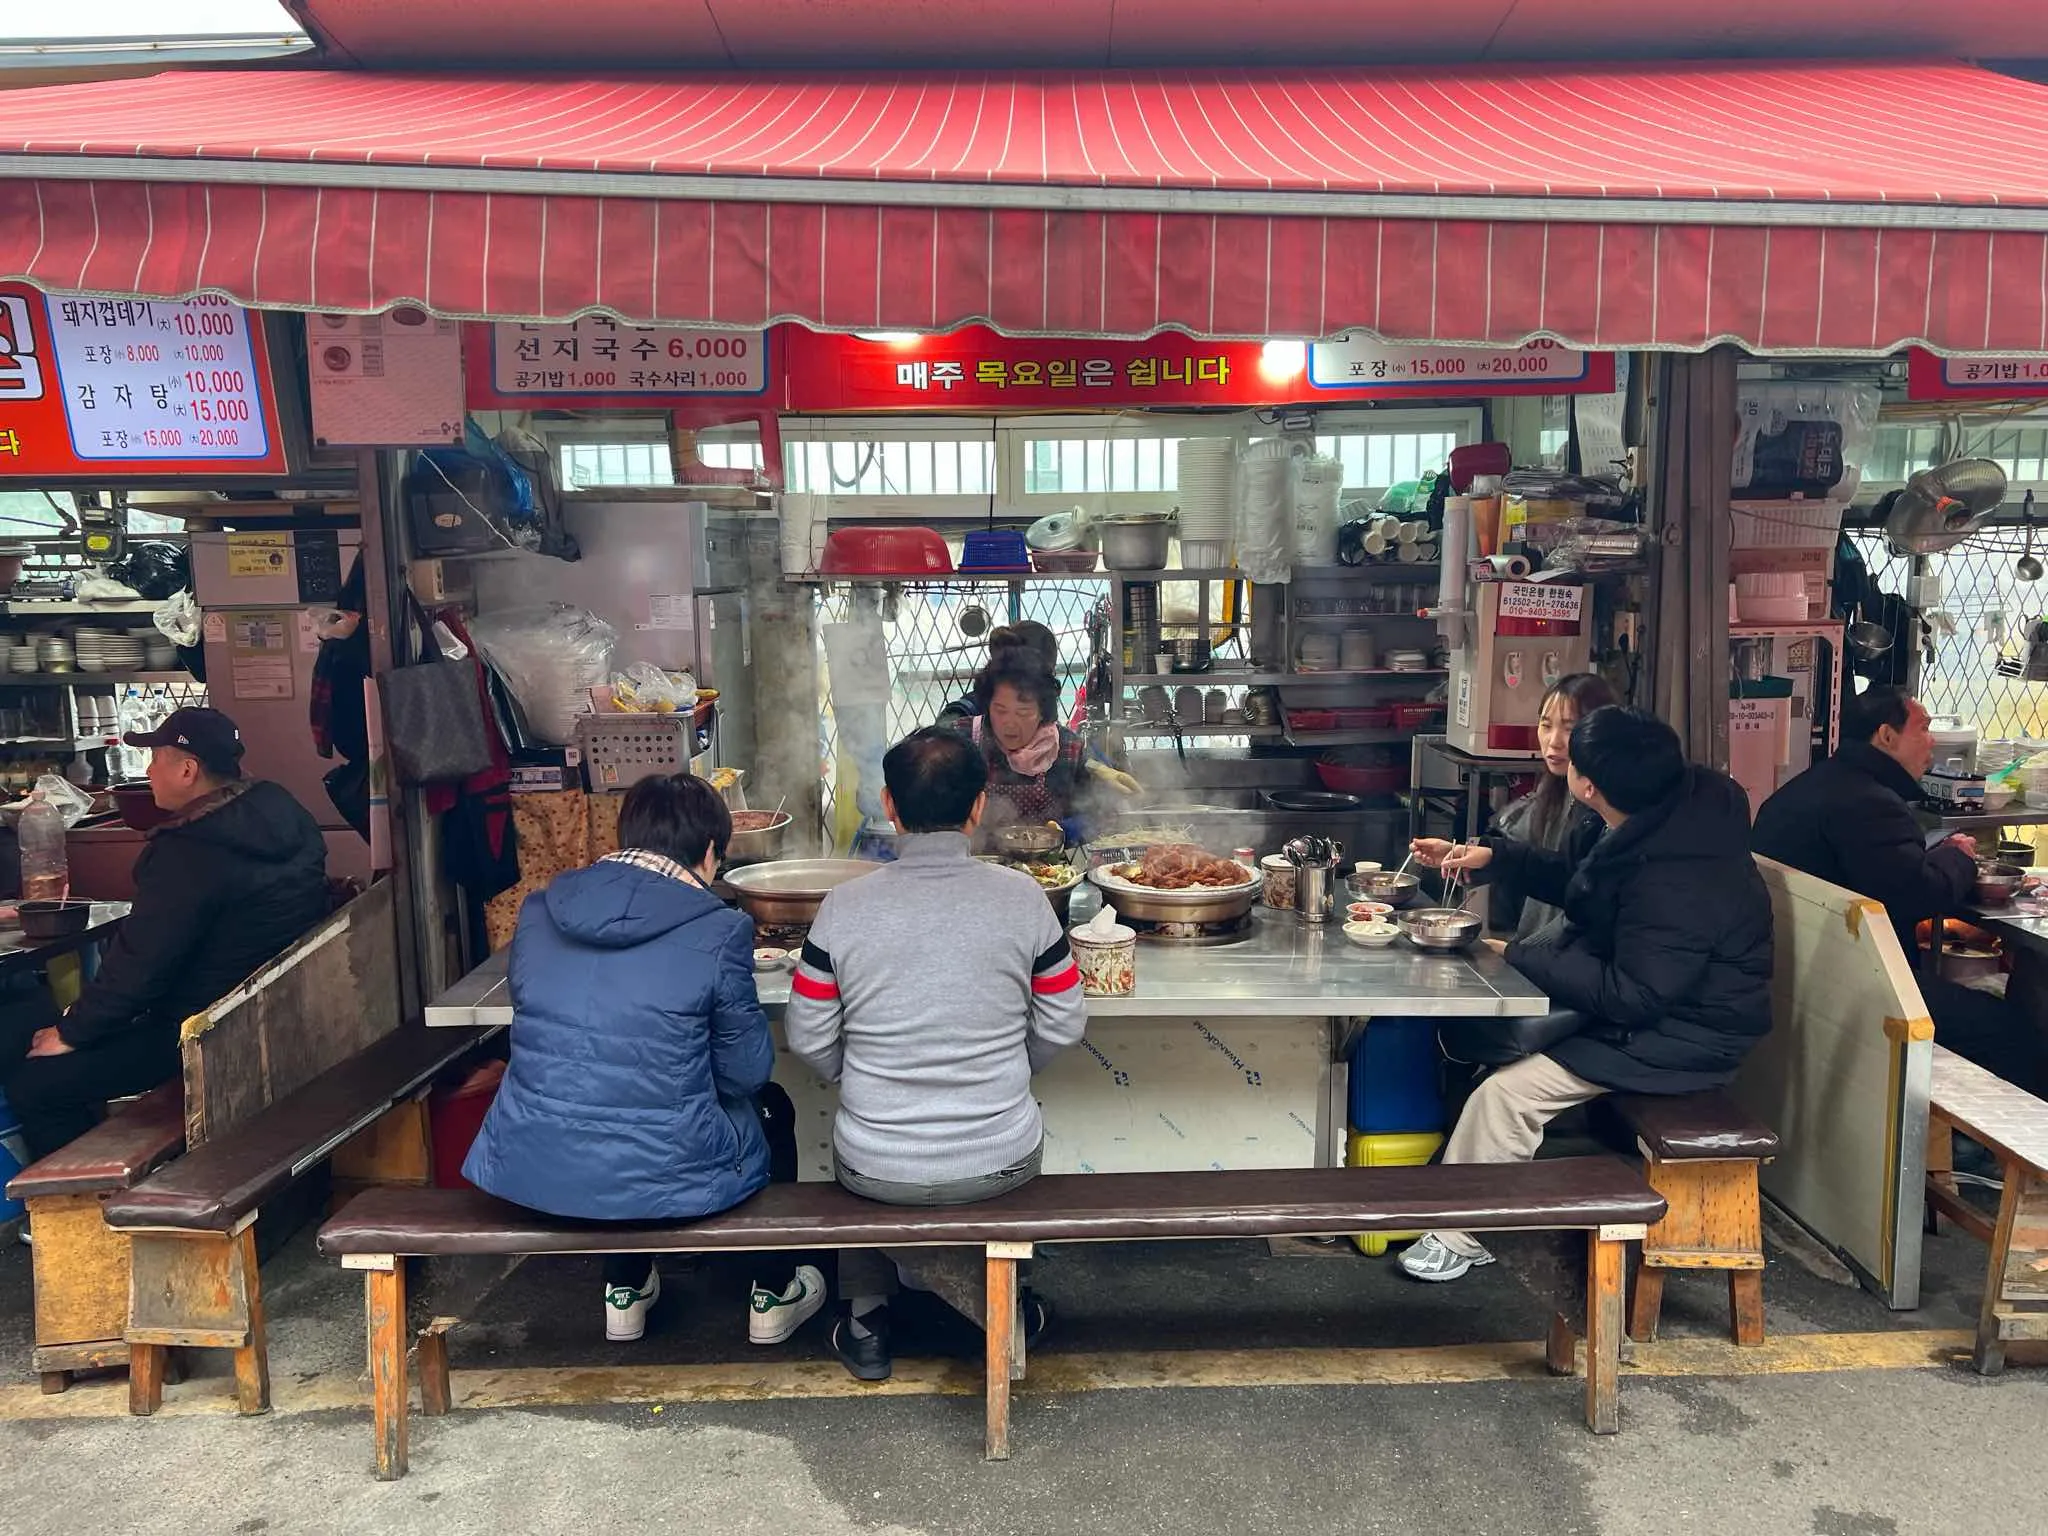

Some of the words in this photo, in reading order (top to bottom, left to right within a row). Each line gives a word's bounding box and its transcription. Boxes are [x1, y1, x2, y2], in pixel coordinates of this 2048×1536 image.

[61, 300, 154, 327] 돼지껍데기
[174, 312, 235, 338] 10,000
[84, 345, 112, 365] 포장
[126, 344, 160, 362] 8,000
[185, 344, 224, 362] 10,000
[667, 338, 748, 361] 6,000
[896, 360, 964, 390] 매주
[976, 359, 1115, 390] 목요일은
[1126, 355, 1231, 387] 쉽니다
[1349, 359, 1387, 378] 포장
[1410, 358, 1466, 376] 15,000
[1492, 356, 1548, 374] 20,000
[1964, 363, 2020, 380] 공기밥
[185, 370, 244, 396] 10,000
[515, 371, 564, 388] 공기밥
[568, 371, 616, 388] 1,000
[629, 371, 695, 388] 국수사리
[700, 371, 748, 388] 1,000
[190, 399, 249, 424] 15,000
[101, 430, 128, 449] 포장
[143, 429, 182, 447] 15,000
[200, 429, 239, 447] 20,000
